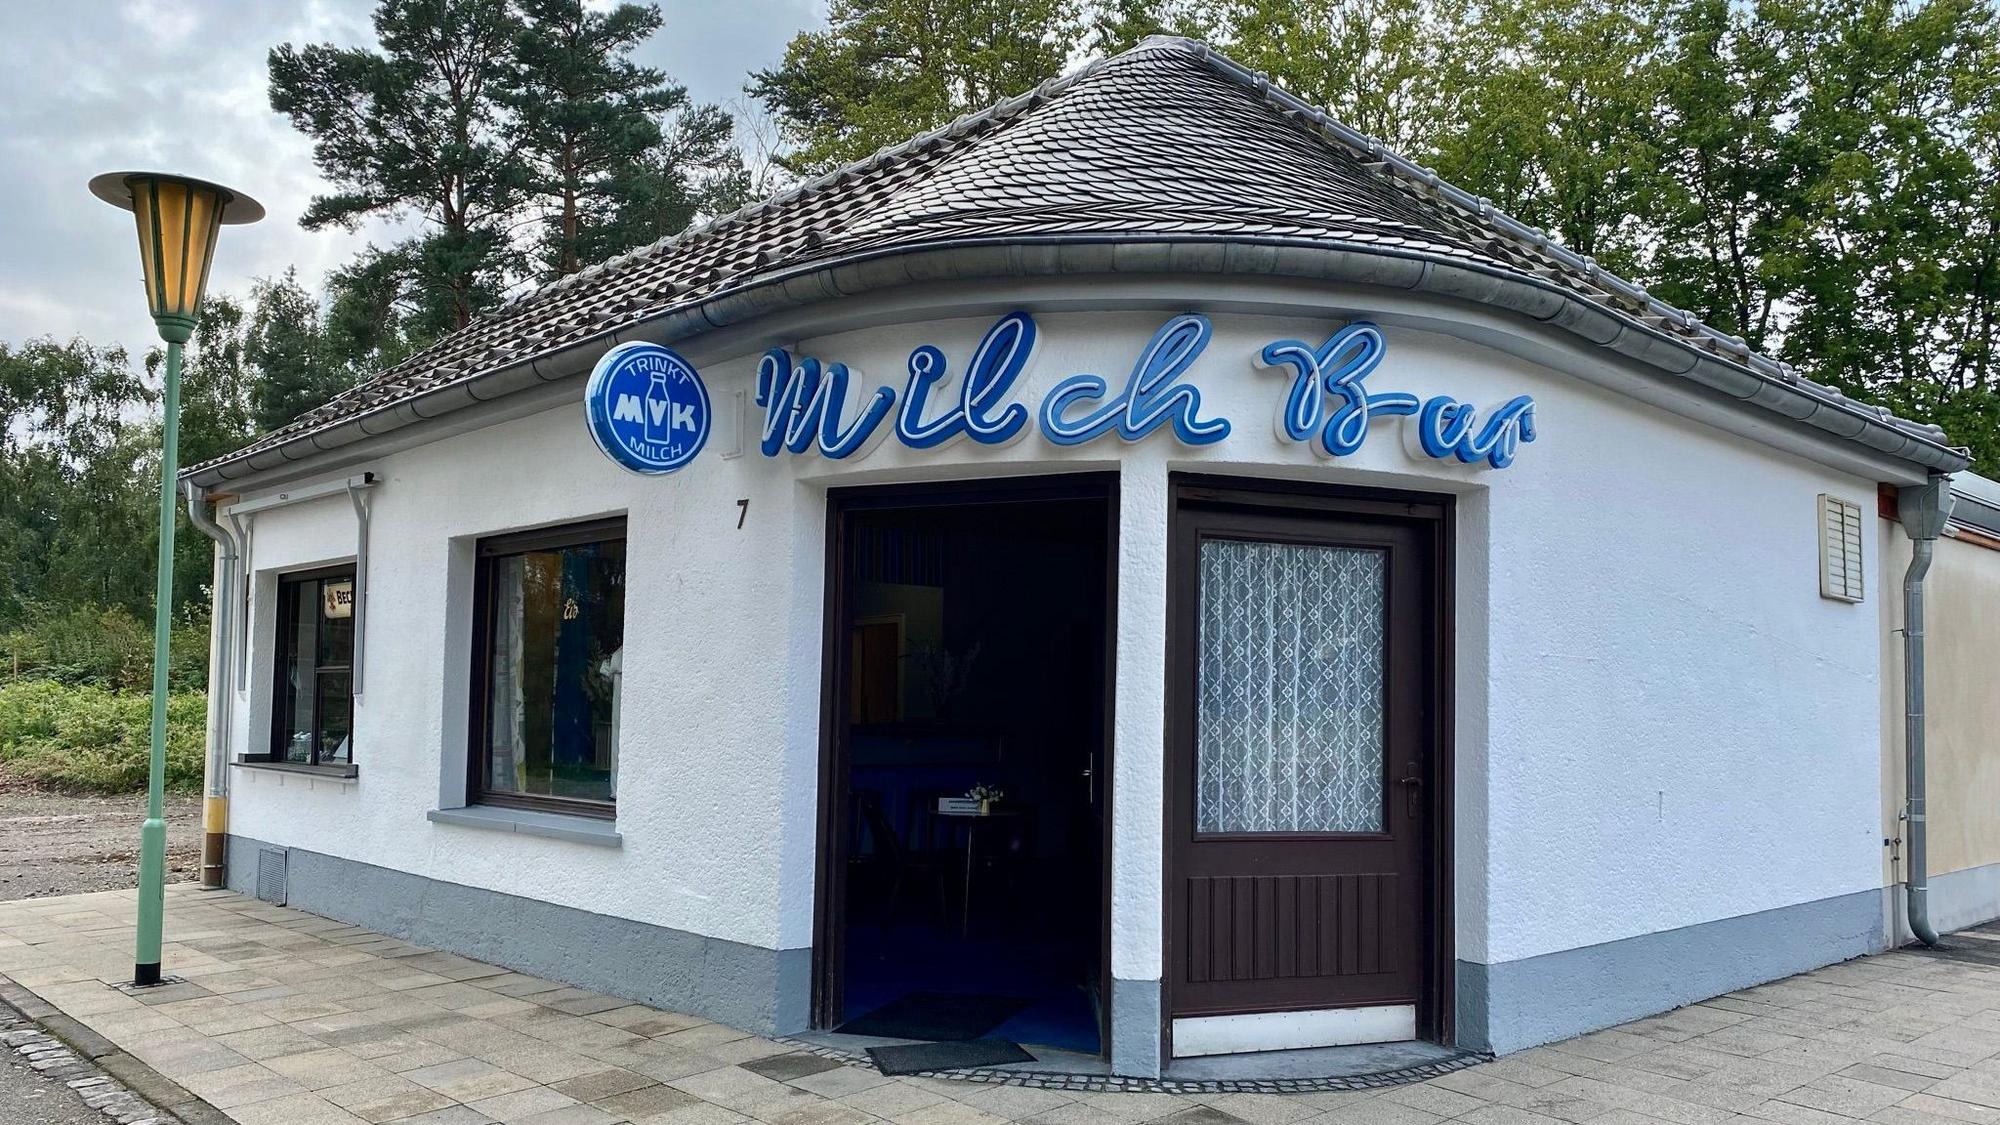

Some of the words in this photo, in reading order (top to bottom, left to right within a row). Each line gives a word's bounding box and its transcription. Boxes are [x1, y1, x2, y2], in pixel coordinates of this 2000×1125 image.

[625, 357, 690, 384] TRINKT
[756, 311, 1231, 460] Milch
[1261, 321, 1536, 469] Bar
[613, 393, 696, 432] MVK
[630, 436, 682, 459] MILCH
[737, 499, 749, 529] 7
